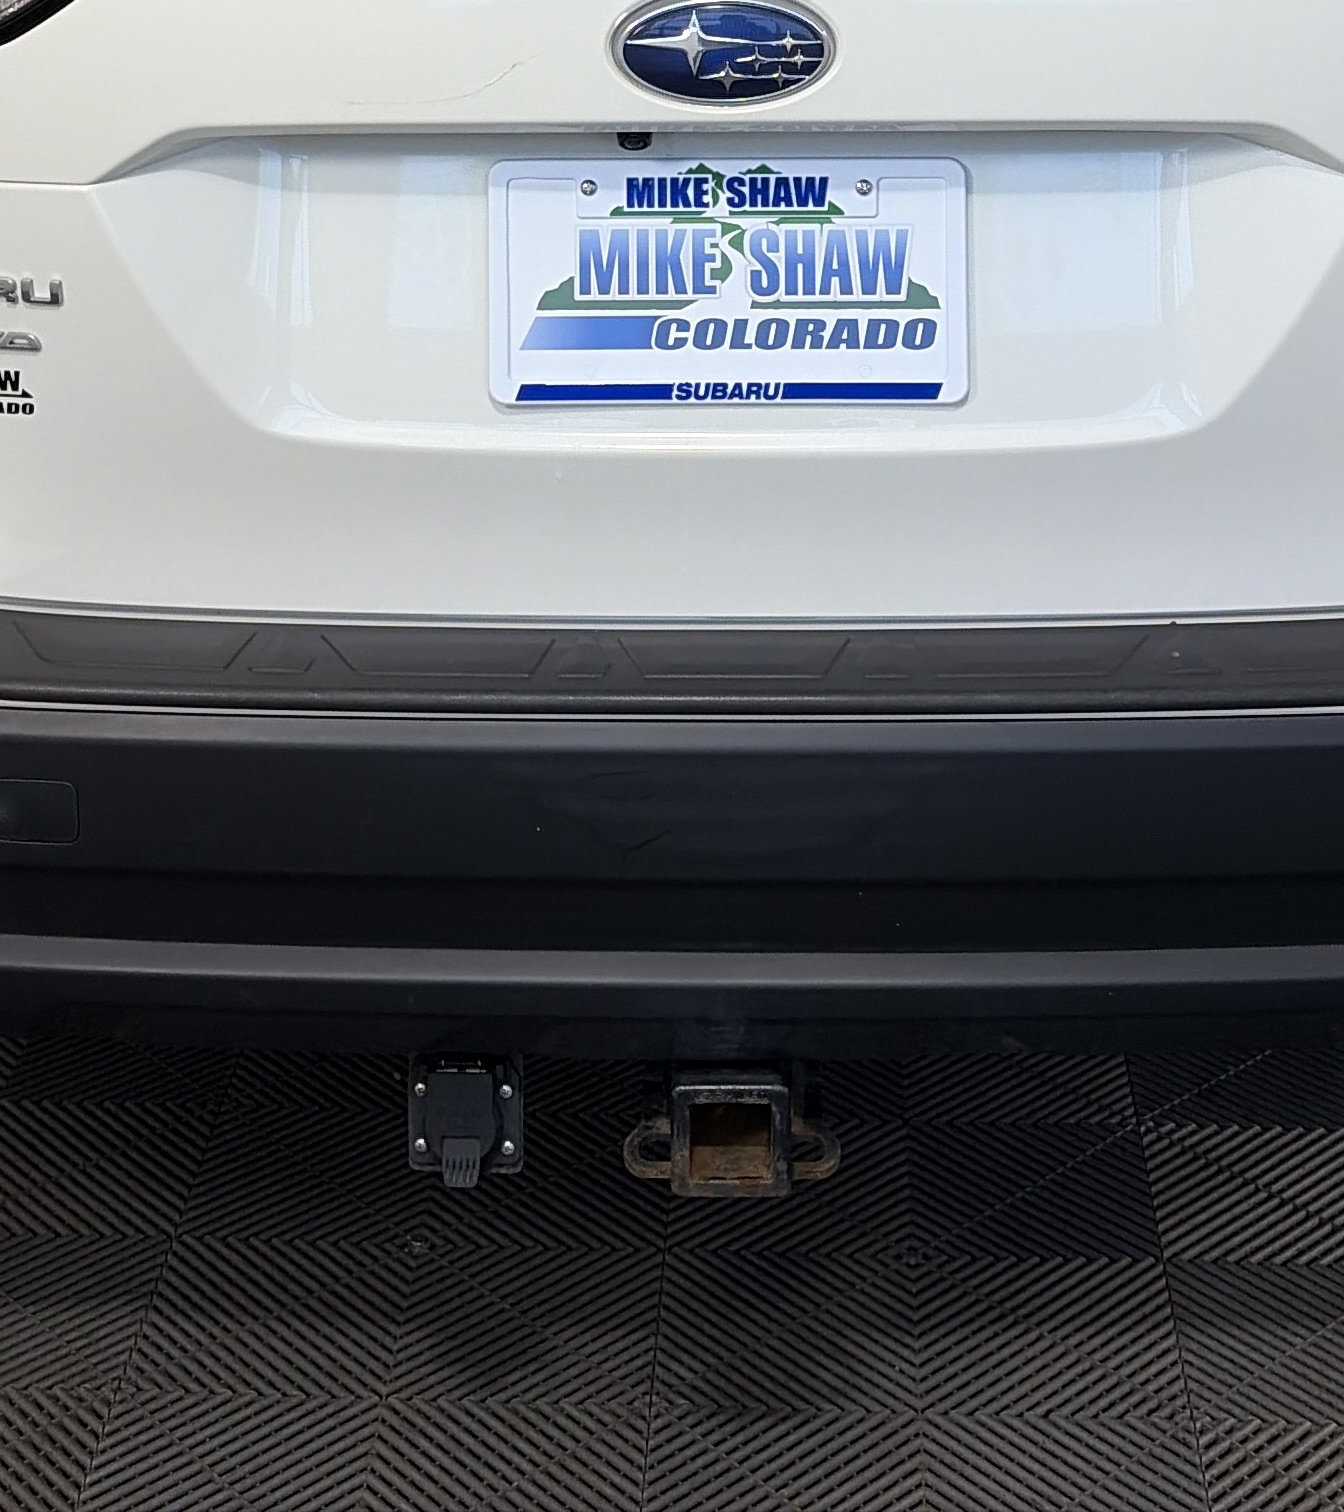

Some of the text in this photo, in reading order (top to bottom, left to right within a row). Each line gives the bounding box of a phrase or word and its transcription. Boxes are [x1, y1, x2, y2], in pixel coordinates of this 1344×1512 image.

[626, 176, 829, 209] MIKE SHAW
[578, 226, 910, 296] MIKE SHAW
[654, 318, 939, 350] COLORADO
[674, 382, 781, 401] SUBARU
